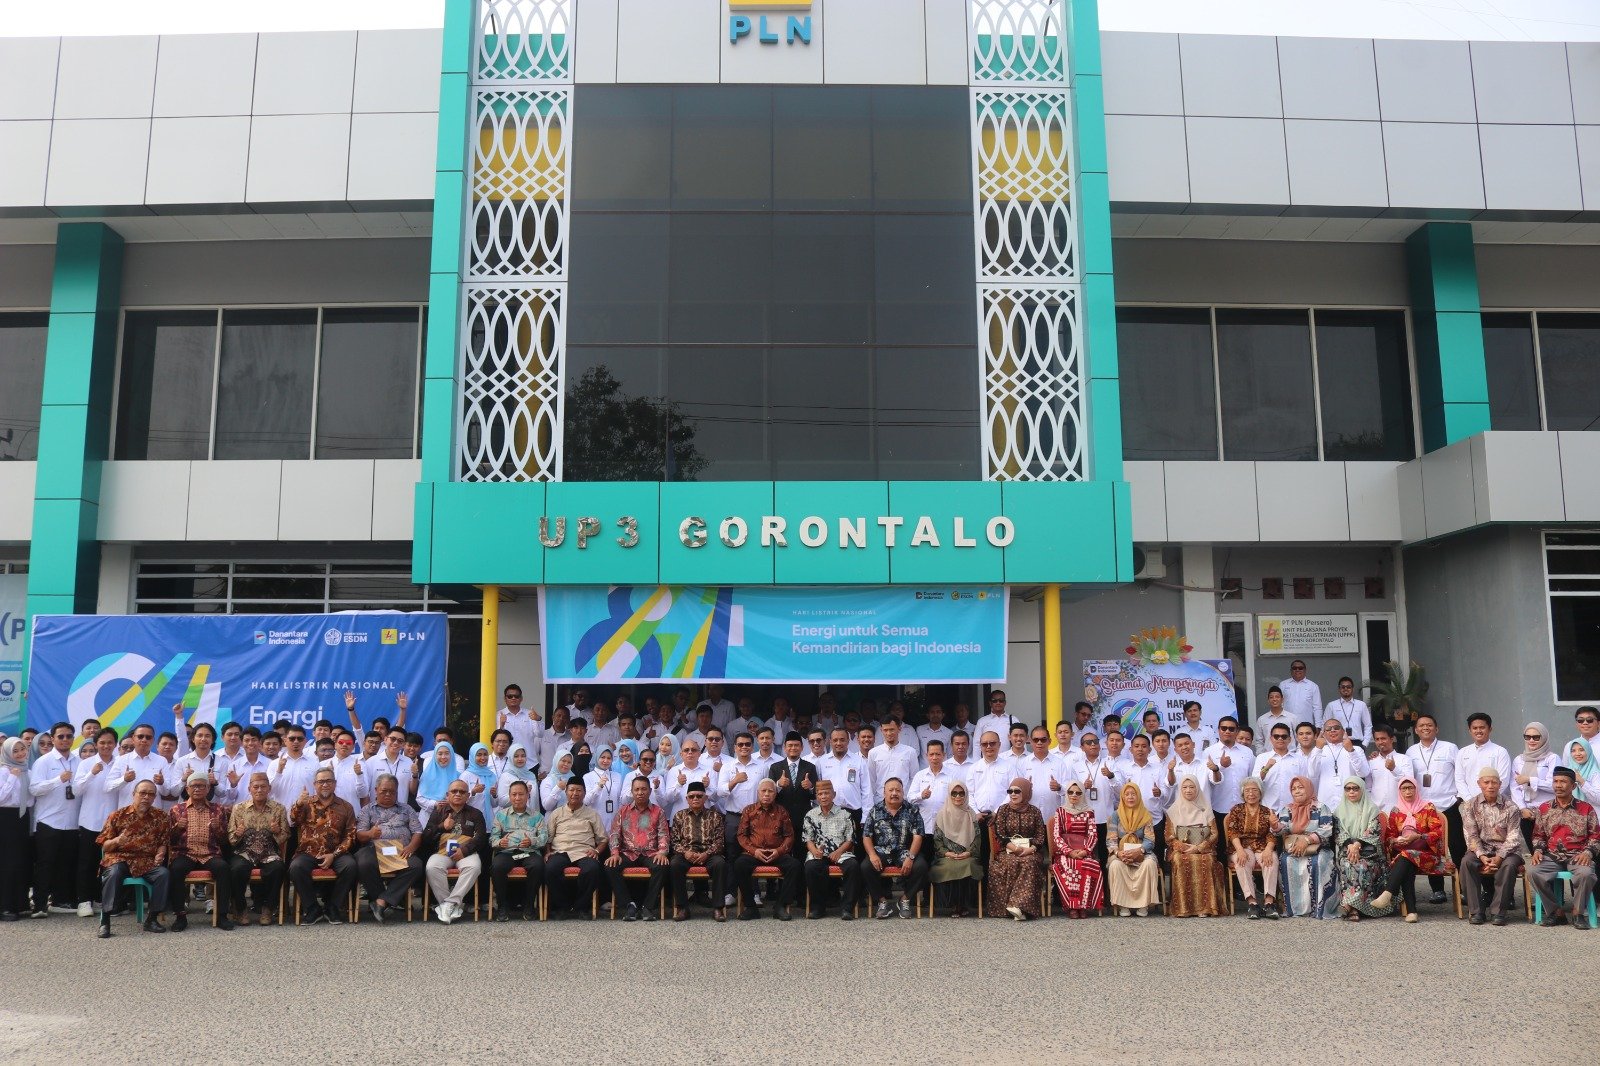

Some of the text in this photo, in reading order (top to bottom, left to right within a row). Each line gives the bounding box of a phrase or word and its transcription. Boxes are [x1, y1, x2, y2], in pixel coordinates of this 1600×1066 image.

[729, 15, 812, 45] PLN
[678, 515, 1016, 549] GORONTALO
[268, 630, 309, 638] Danantara
[399, 632, 425, 641] PLN
[792, 624, 929, 640] Energi untuk Semua
[268, 637, 306, 645] Indonesia
[792, 641, 982, 657] Kemandirian bagi Indonesia
[251, 681, 396, 690] HARI LISTRIK NASIONAL
[1101, 675, 1219, 697] Selamat Memperingati
[249, 705, 323, 730] Energi
